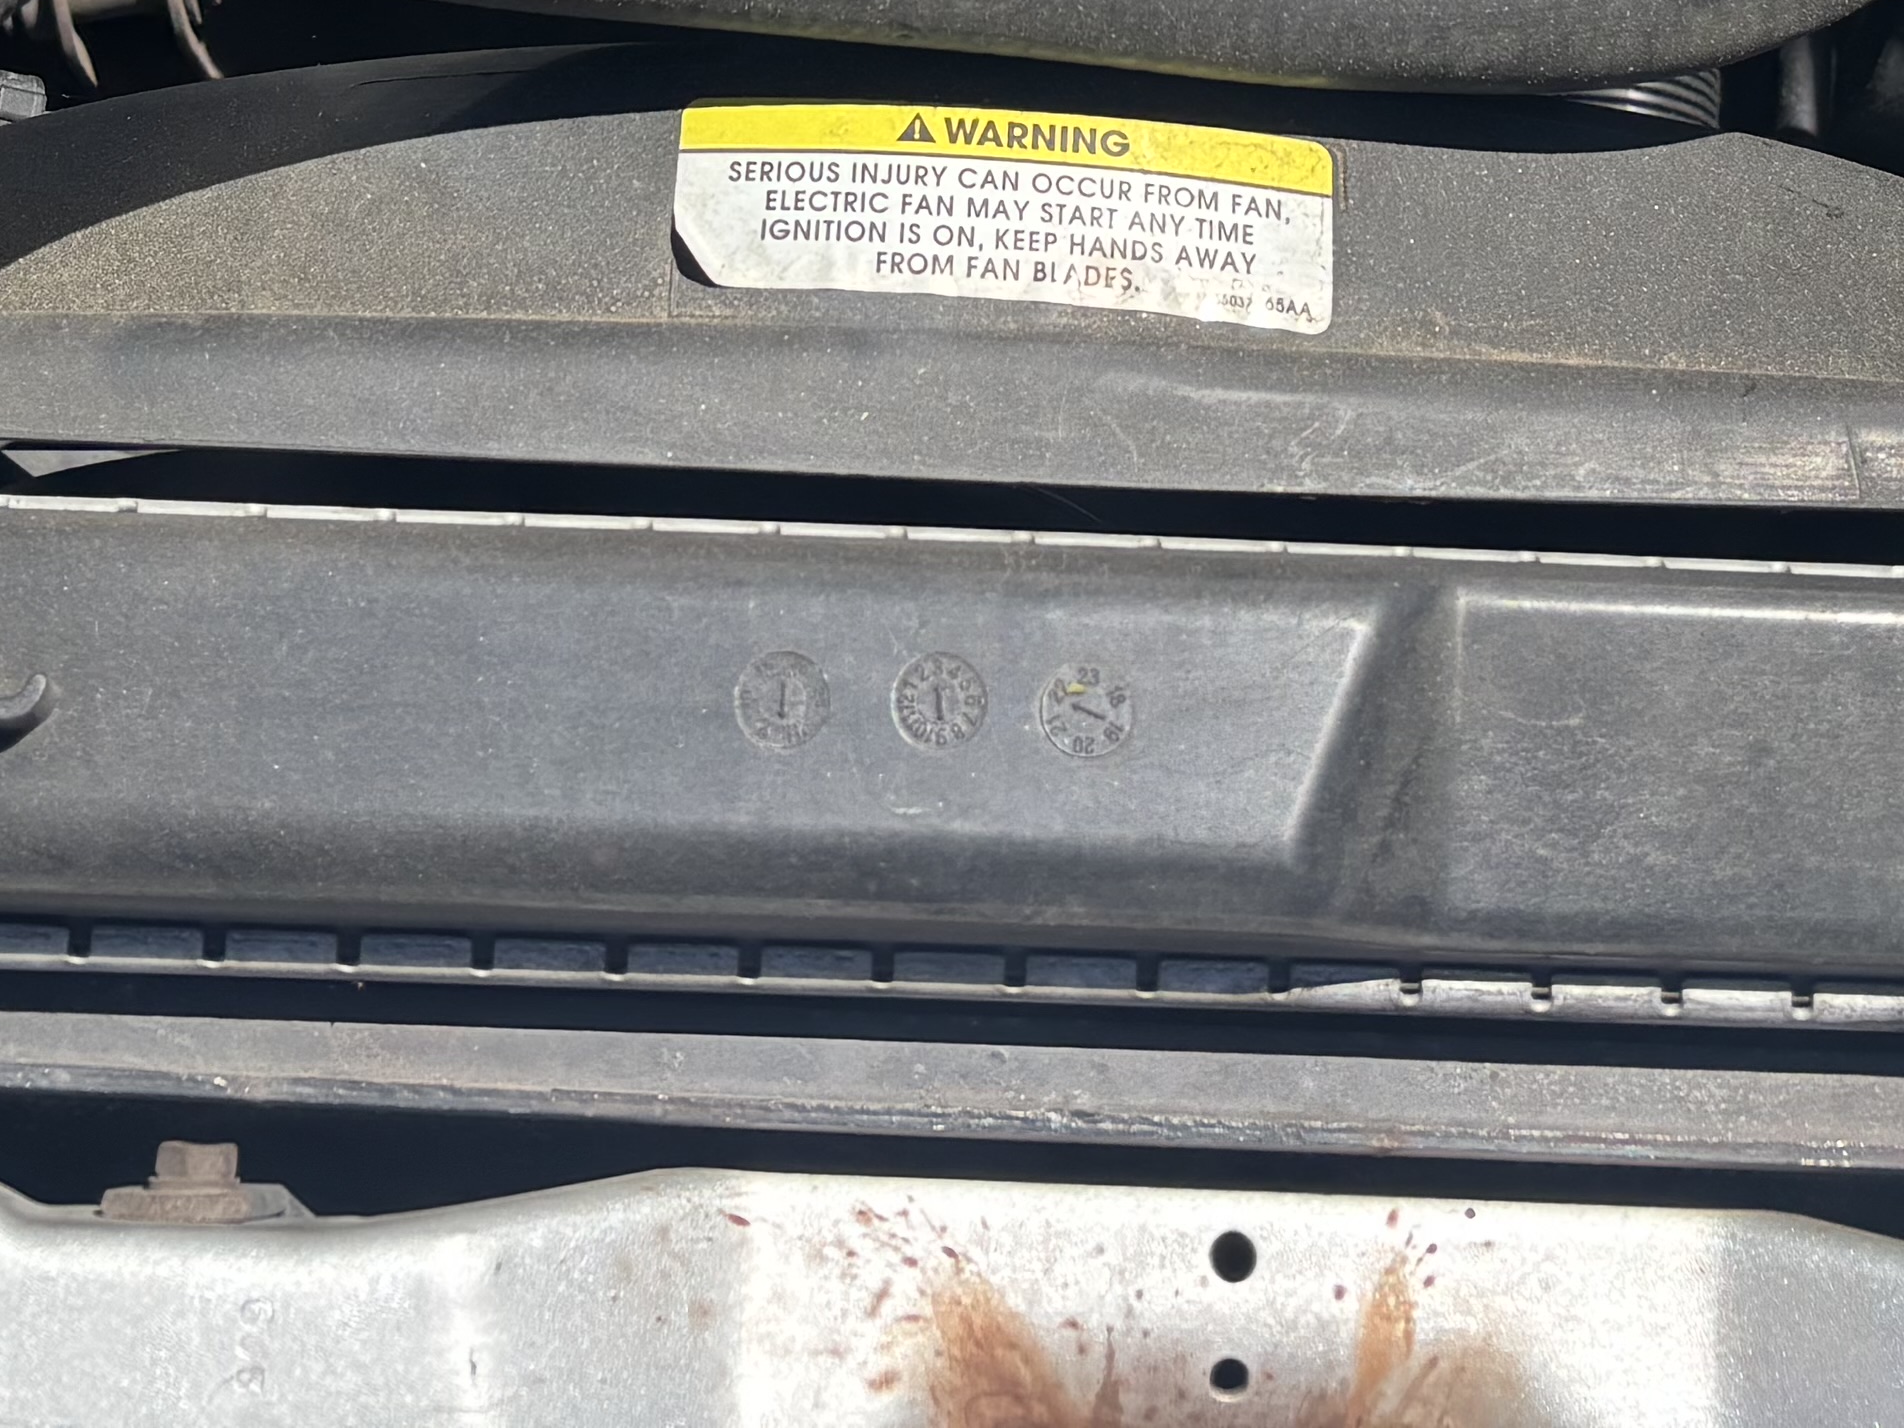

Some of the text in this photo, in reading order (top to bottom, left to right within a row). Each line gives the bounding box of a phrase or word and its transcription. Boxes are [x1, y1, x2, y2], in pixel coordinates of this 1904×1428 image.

[943, 116, 1130, 158] WARNING
[728, 160, 1291, 226] SERIOUS INJURY CAN OCCUR FROM FAN,
[765, 189, 1255, 246] ELECTRIC FAN MAY START ANY TIME
[759, 218, 1256, 275] IGNITION IS ON, KEEP HANDS AWAY
[875, 251, 1141, 292] FROM FAN BLADES.
